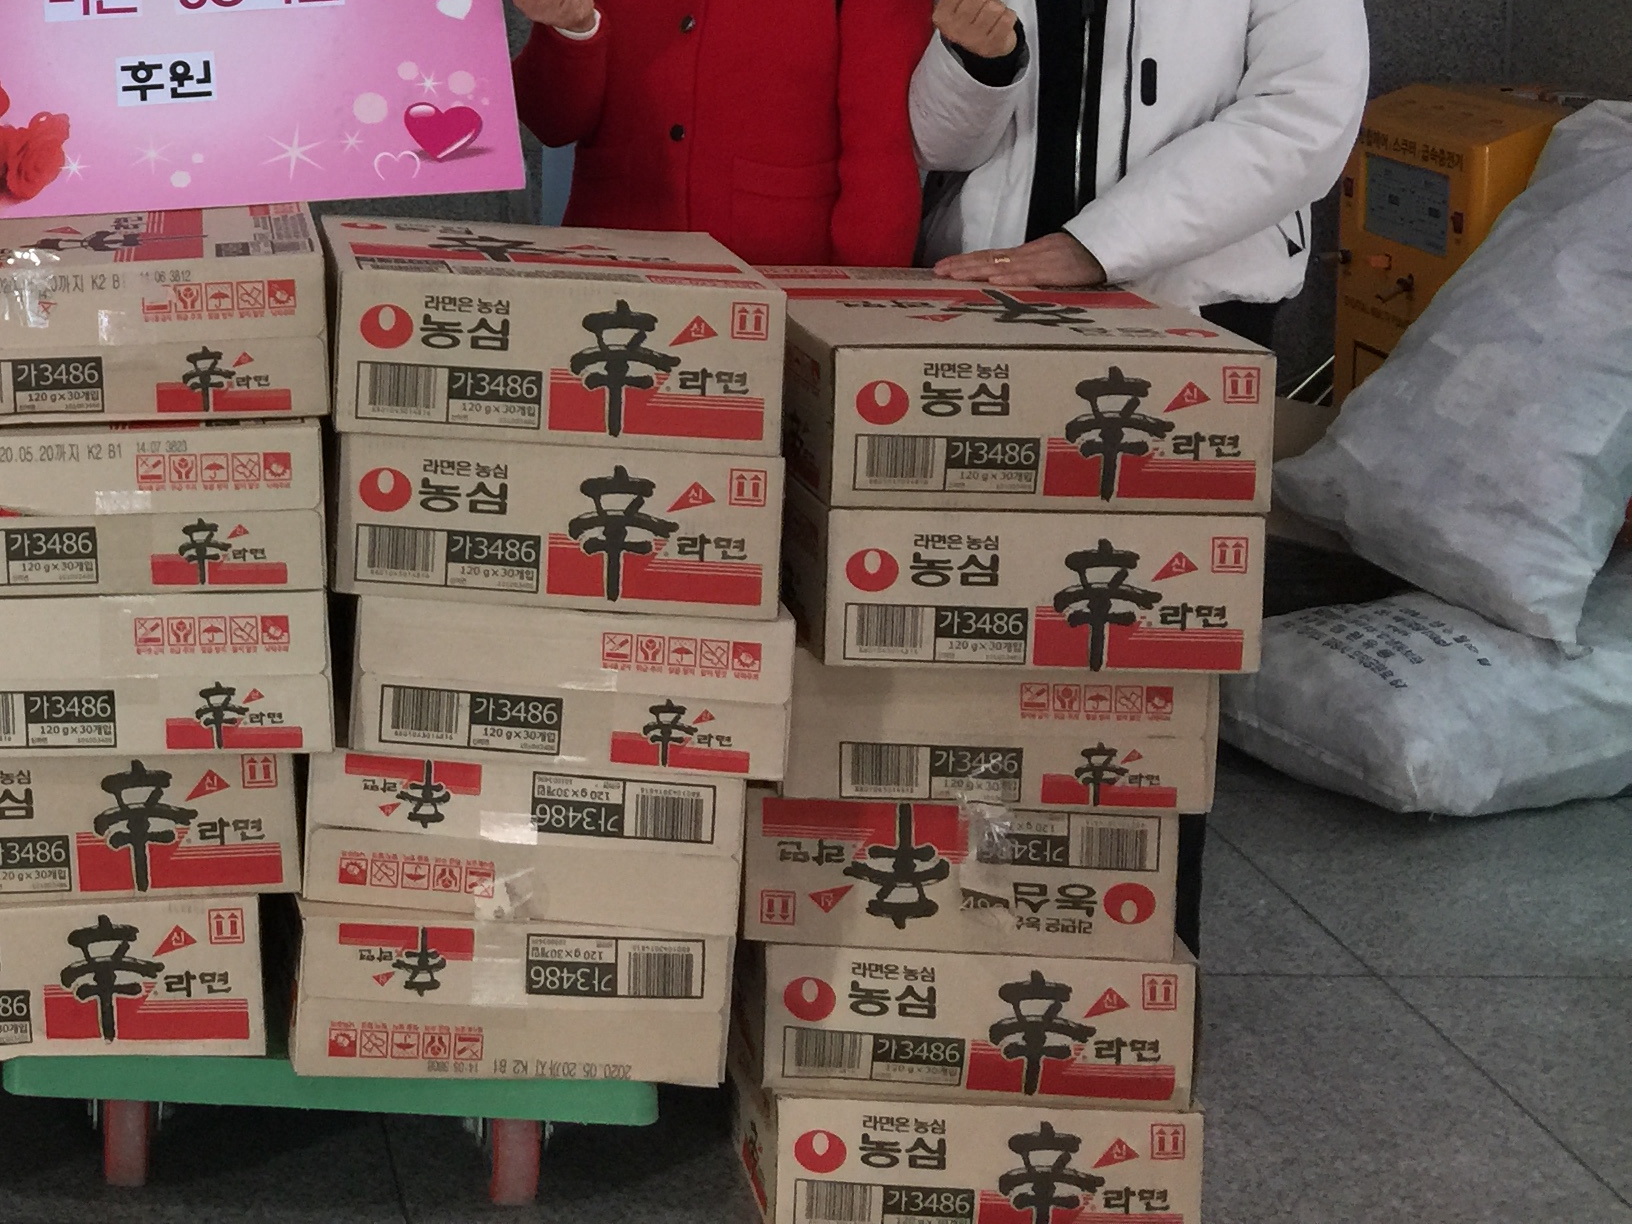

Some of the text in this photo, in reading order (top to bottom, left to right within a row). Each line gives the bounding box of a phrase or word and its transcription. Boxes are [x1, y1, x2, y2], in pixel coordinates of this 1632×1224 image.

[120, 60, 213, 102] 후원
[424, 295, 510, 316] 라면은 농심
[419, 310, 510, 352] 농심
[17, 362, 99, 387] 가3486
[452, 371, 538, 399] 가3486
[675, 367, 750, 397] 라면
[923, 362, 1010, 380] 라면은 농심
[1064, 365, 1177, 504] 辛
[950, 440, 1036, 465] 가3486
[474, 697, 558, 725] 가3486
